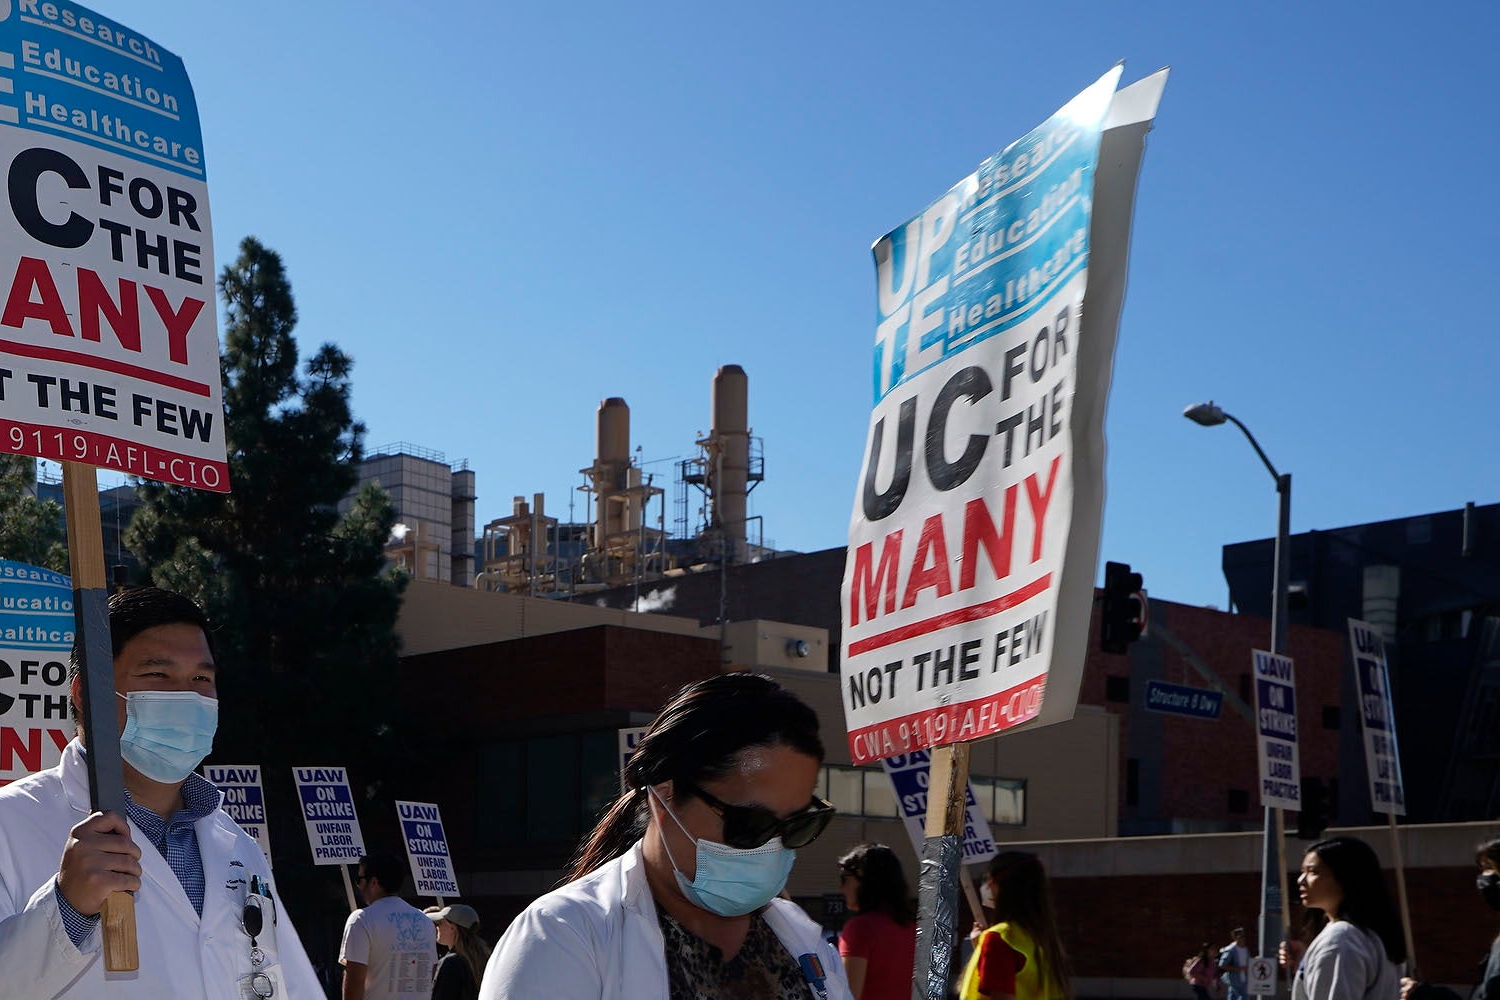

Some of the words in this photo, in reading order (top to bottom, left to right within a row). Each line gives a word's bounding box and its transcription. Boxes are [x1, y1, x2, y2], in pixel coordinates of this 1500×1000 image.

[20, 0, 160, 63] Research
[23, 41, 178, 112] Education
[26, 91, 200, 164] Healthcare
[99, 165, 202, 232] FOR
[100, 218, 202, 285] THE
[876, 281, 949, 394] TE
[27, 374, 118, 420] THE
[132, 394, 213, 443] FEW
[862, 366, 993, 521] UC
[1000, 305, 1069, 402] FOR
[995, 377, 1064, 469] THE
[10, 428, 88, 459] 9119
[850, 454, 1062, 627] MANY
[849, 660, 903, 711] NOT
[913, 639, 984, 692] THE
[993, 609, 1050, 673] FEW
[1256, 654, 1291, 681] UAW
[20, 661, 67, 687] FO
[19, 694, 68, 720] TH
[1149, 687, 1190, 708] Structure
[1268, 685, 1285, 709] ON
[1260, 707, 1296, 736] STRIKE
[853, 731, 896, 761] CWA
[1266, 741, 1293, 762] UNFAIR
[210, 769, 258, 783] UAW
[298, 769, 343, 782] UAW
[1268, 759, 1293, 781] LABOR
[226, 788, 247, 803] ON
[316, 787, 336, 800] ON
[1263, 779, 1300, 802] PRACTICE
[223, 803, 263, 820] TRIKE
[306, 802, 354, 817] STRIKE
[399, 805, 437, 820] UAW
[316, 823, 352, 833] UNFAIR
[416, 824, 433, 838] ON
[321, 835, 353, 845] LABOR
[409, 838, 447, 854] STRIKE
[316, 847, 362, 858] PRACTICE
[417, 857, 446, 868] UNFAIR
[421, 868, 447, 880] LABOR
[417, 880, 457, 892] PRACTICE
